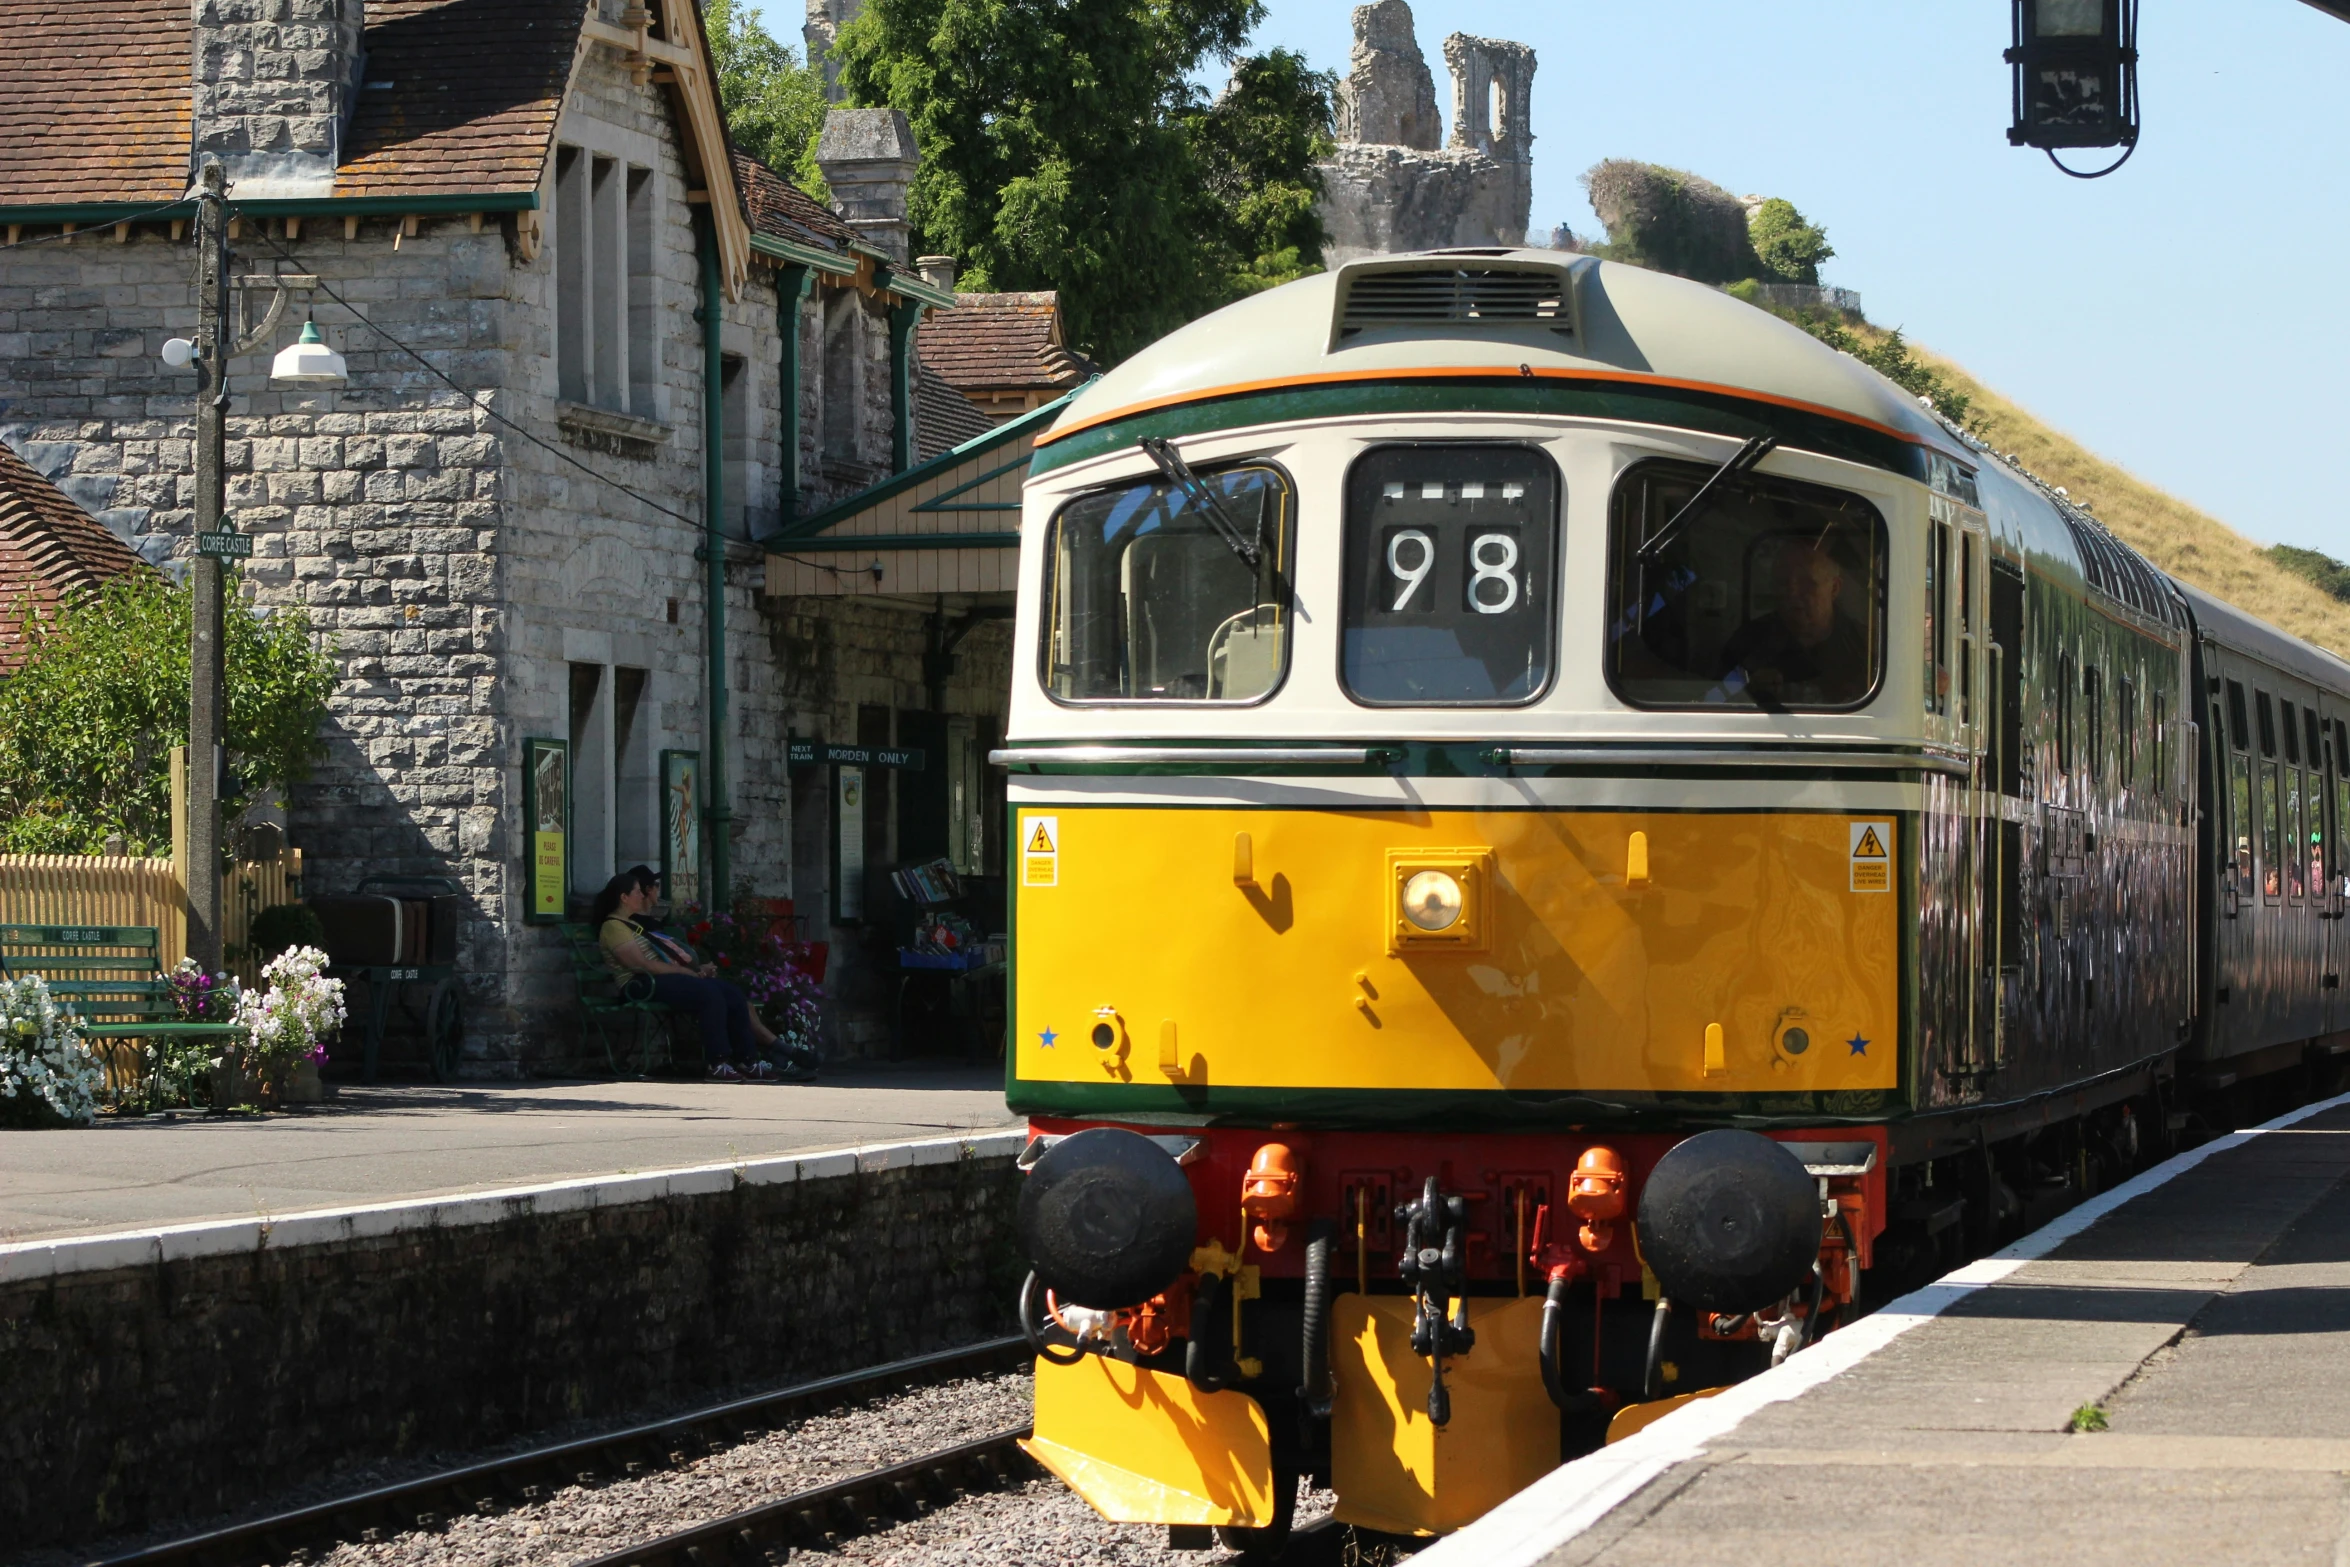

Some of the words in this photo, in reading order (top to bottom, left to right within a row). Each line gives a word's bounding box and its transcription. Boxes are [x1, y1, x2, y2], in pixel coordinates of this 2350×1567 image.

[202, 535, 225, 552] CORFE
[226, 537, 251, 554] CASTLE
[791, 745, 811, 753] NEXT
[828, 749, 869, 762] NORDEN
[878, 752, 909, 765] ONLY
[543, 841, 557, 852] PLEASE
[62, 931, 79, 941] CORFE
[82, 931, 100, 941] CASTLE
